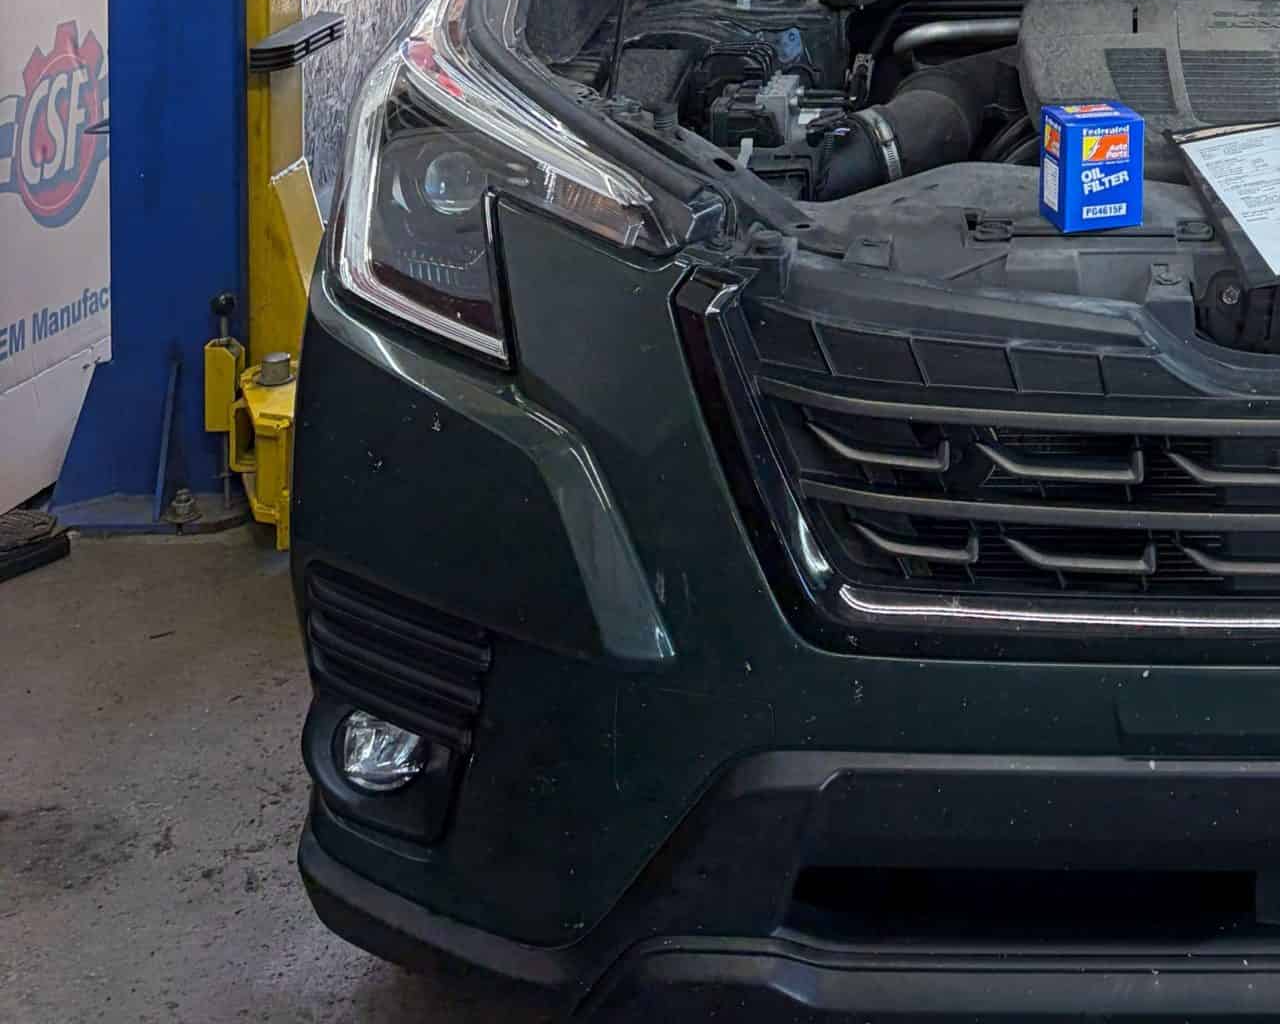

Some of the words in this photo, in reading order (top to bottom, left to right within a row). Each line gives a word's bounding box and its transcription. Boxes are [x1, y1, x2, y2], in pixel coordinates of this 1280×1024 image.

[21, 68, 89, 185] CSF
[1081, 167, 1105, 183] OIL
[1083, 170, 1130, 195] FILTER
